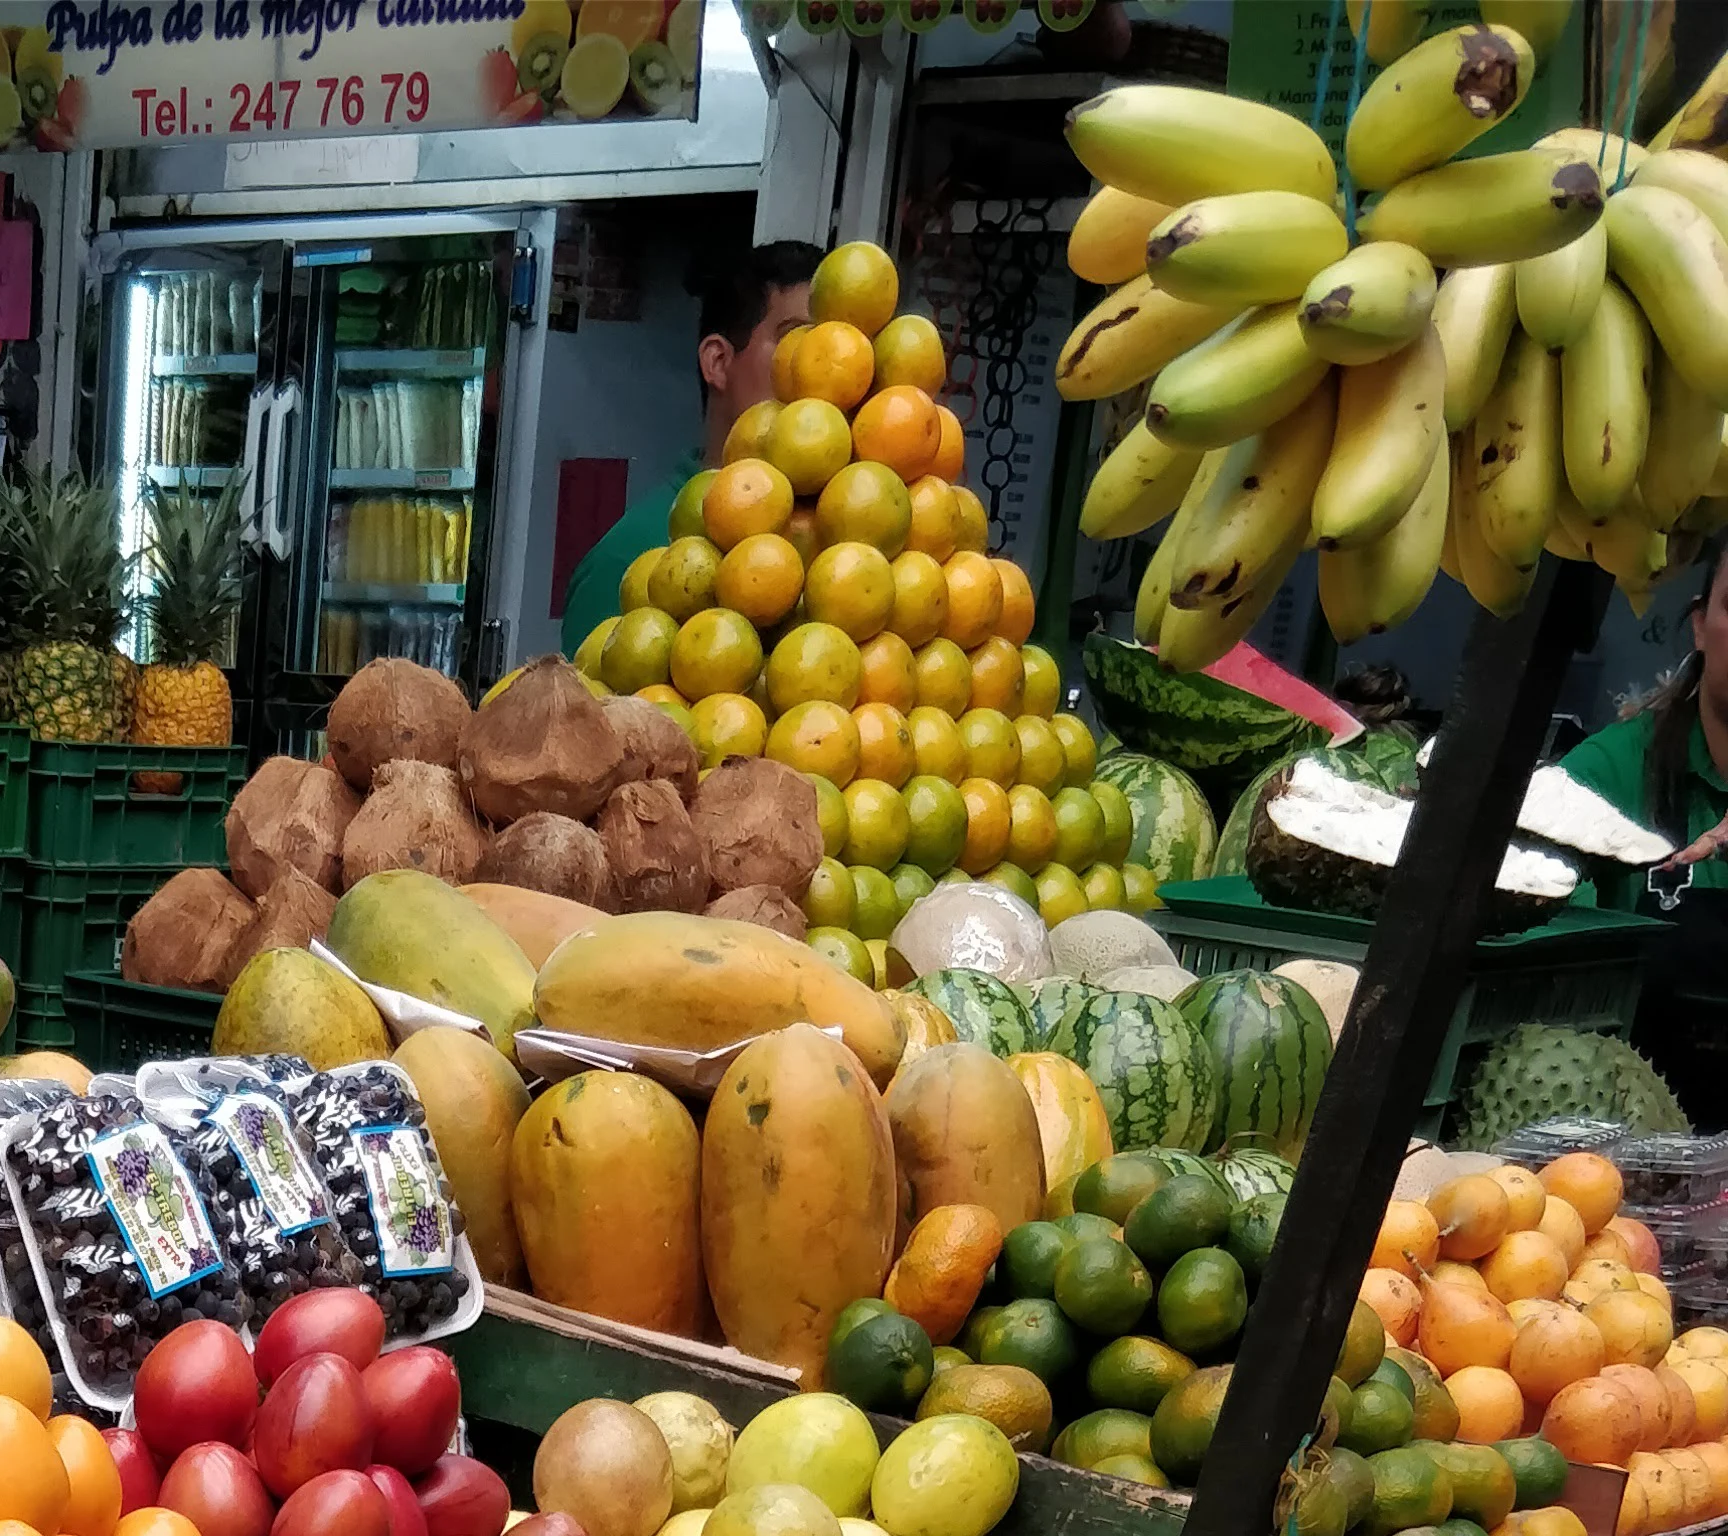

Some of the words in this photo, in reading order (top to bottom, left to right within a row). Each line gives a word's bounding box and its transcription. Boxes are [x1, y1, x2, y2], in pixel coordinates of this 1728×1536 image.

[46, 0, 152, 75] Pulpa
[162, 0, 204, 45] de
[215, 0, 250, 40] la
[260, 0, 366, 60] mejor
[132, 87, 212, 136] Tel.:
[229, 80, 301, 132] 247
[316, 75, 364, 126] 76
[381, 71, 429, 123] 79
[156, 1235, 186, 1270] EXTRA
